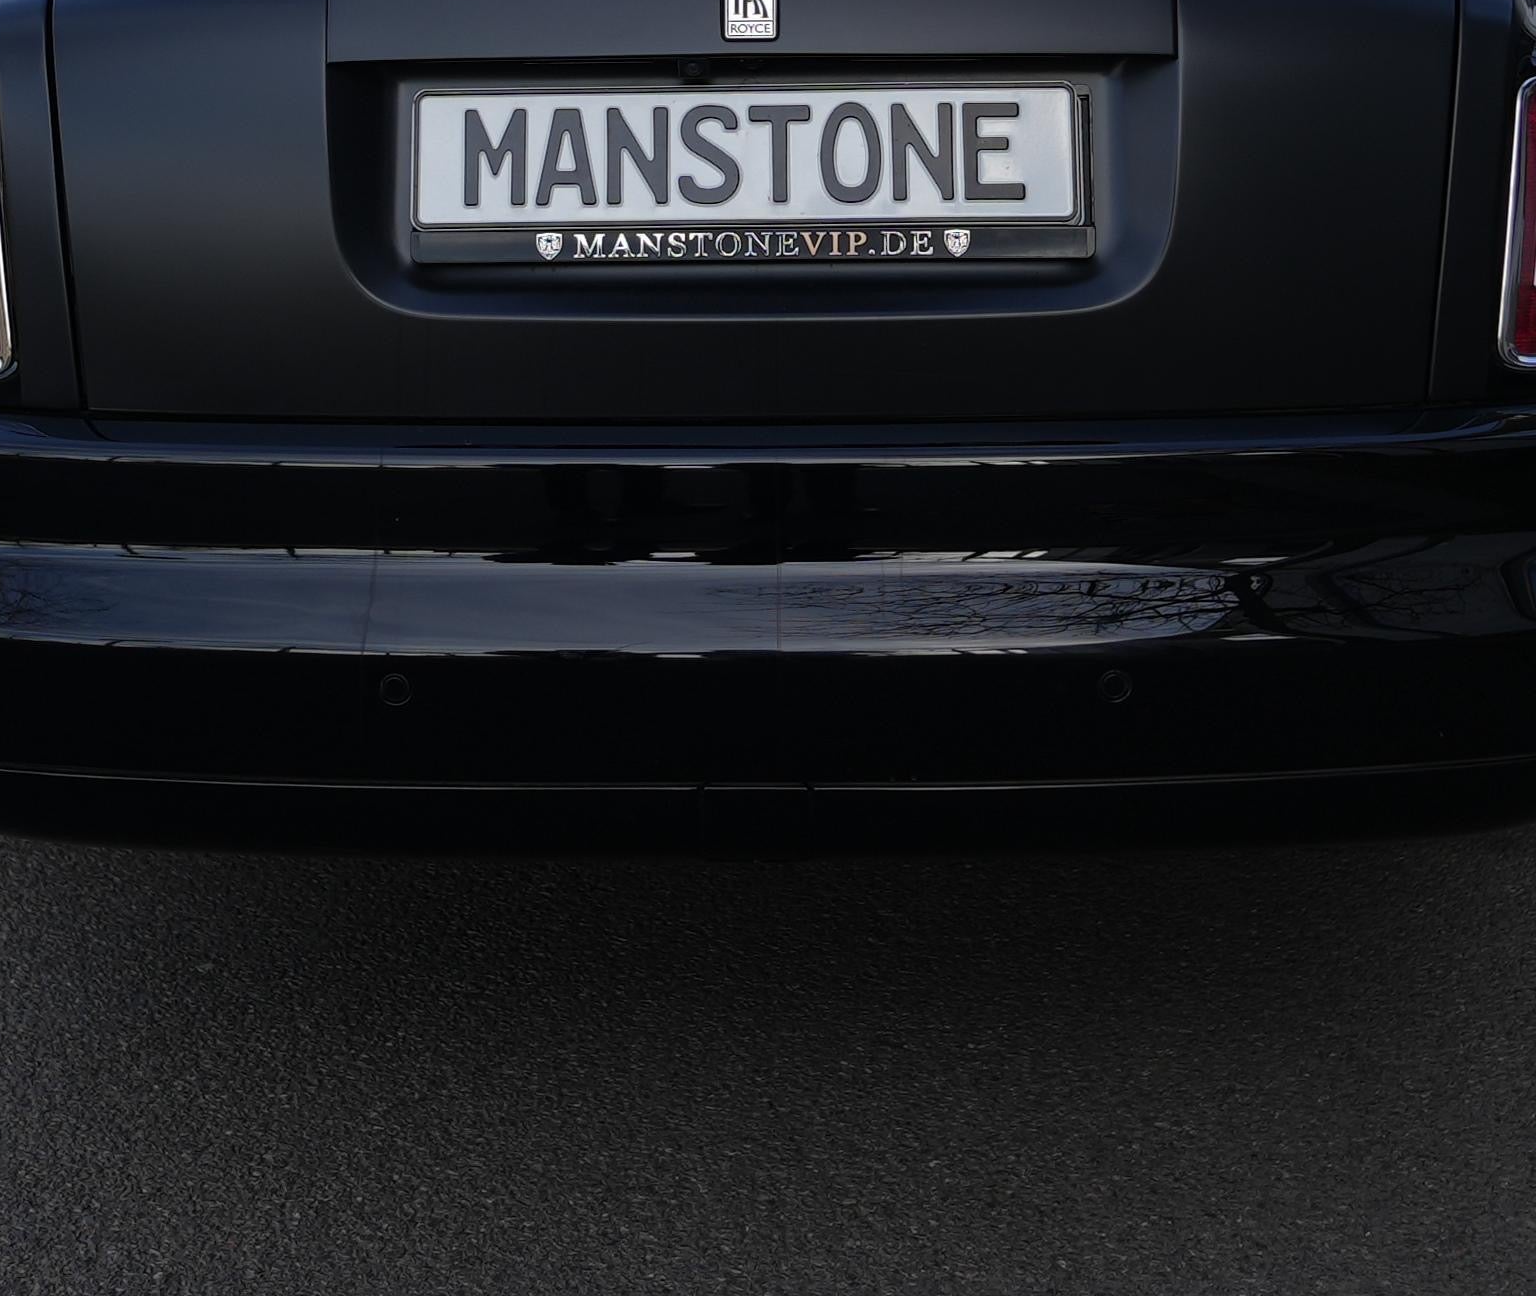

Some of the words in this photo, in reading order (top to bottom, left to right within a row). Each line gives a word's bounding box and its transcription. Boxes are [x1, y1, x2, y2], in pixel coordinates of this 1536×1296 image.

[730, 24, 771, 34] ROYCE
[463, 102, 1027, 206] MANSTONE
[573, 231, 935, 259] MANSTONEVIP.DE
